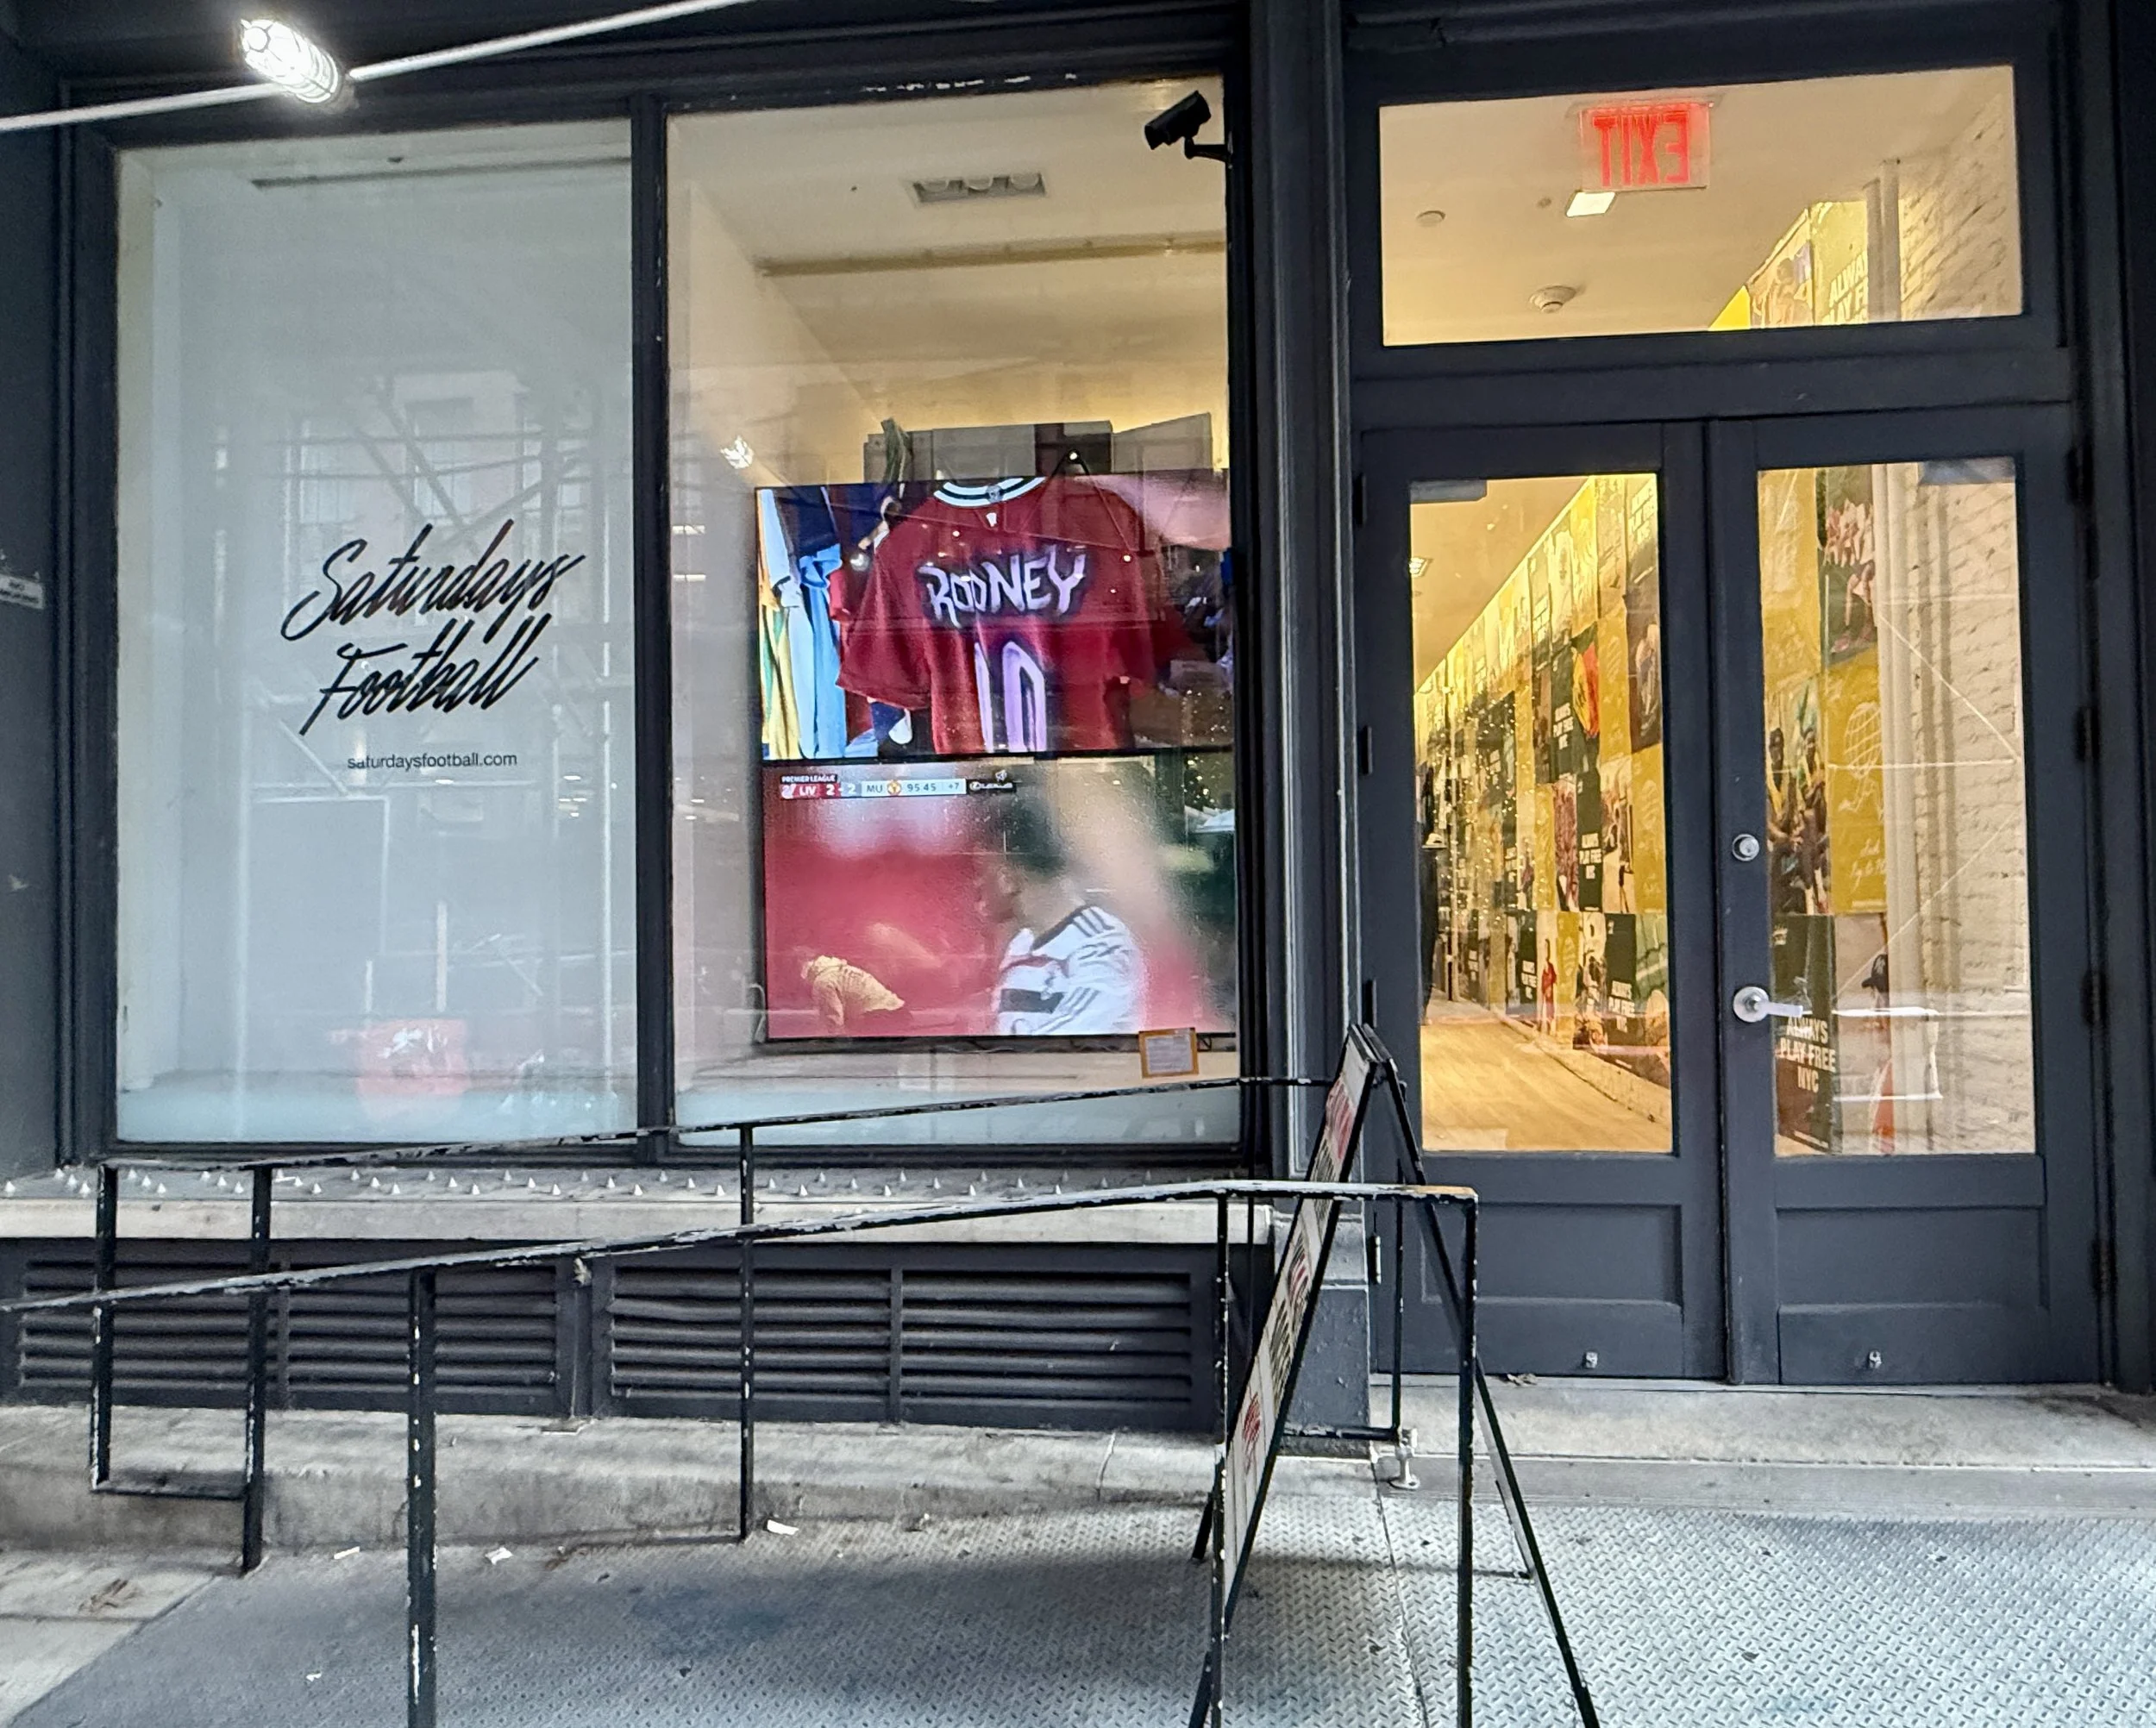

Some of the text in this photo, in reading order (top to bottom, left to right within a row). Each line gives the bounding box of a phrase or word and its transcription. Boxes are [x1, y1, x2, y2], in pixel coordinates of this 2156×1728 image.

[280, 518, 586, 642] Saturdays
[298, 613, 553, 736] Football
[347, 751, 518, 769] saturdaysfootball.com
[799, 786, 817, 796] LIV
[825, 783, 836, 796] 2
[866, 784, 884, 793] MU
[1786, 1017, 1828, 1044] ALWAYS
[1779, 1036, 1837, 1074] PLAY FREE
[1796, 1065, 1820, 1093] NYC
